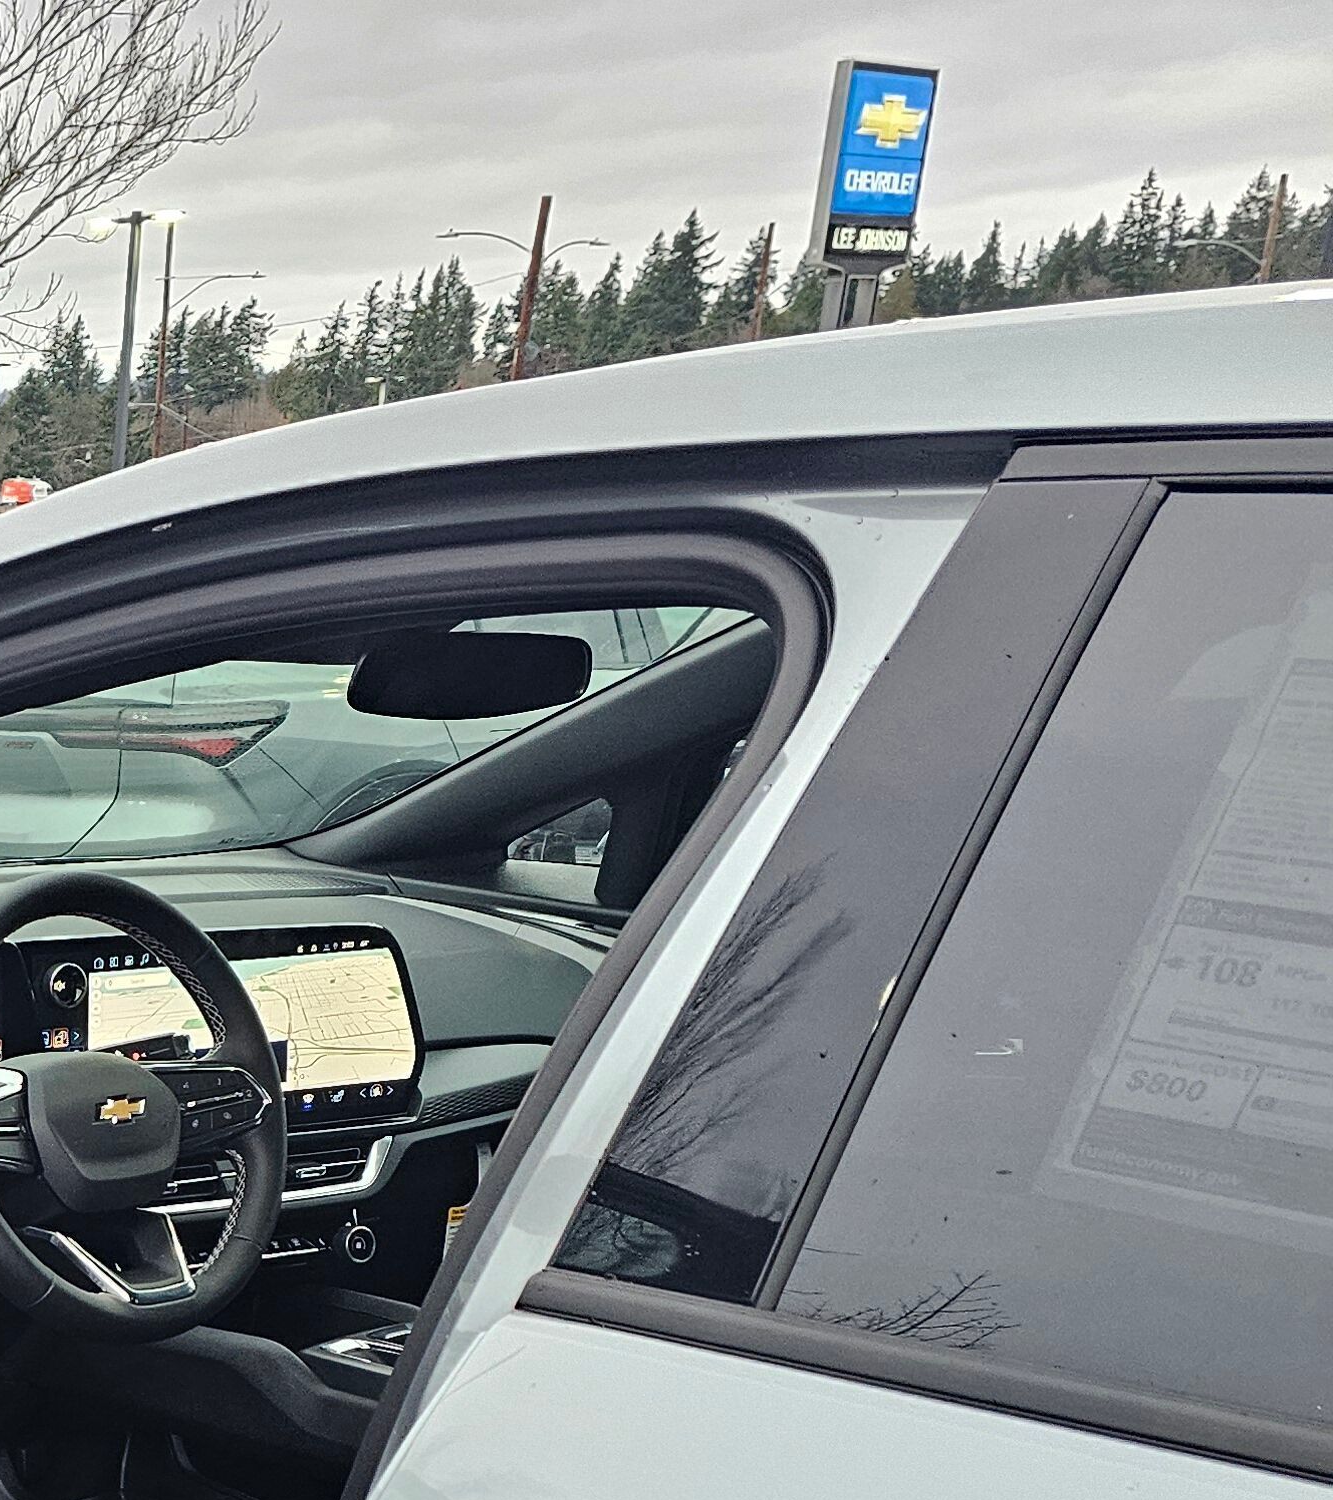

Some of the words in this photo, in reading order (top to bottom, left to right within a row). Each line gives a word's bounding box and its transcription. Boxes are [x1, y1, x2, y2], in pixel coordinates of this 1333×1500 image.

[843, 168, 916, 195] CHEVROLET
[831, 226, 856, 250] LEE
[856, 227, 909, 252] JOHNSON
[1197, 955, 1262, 988] 108
[1125, 1069, 1208, 1102] $800
